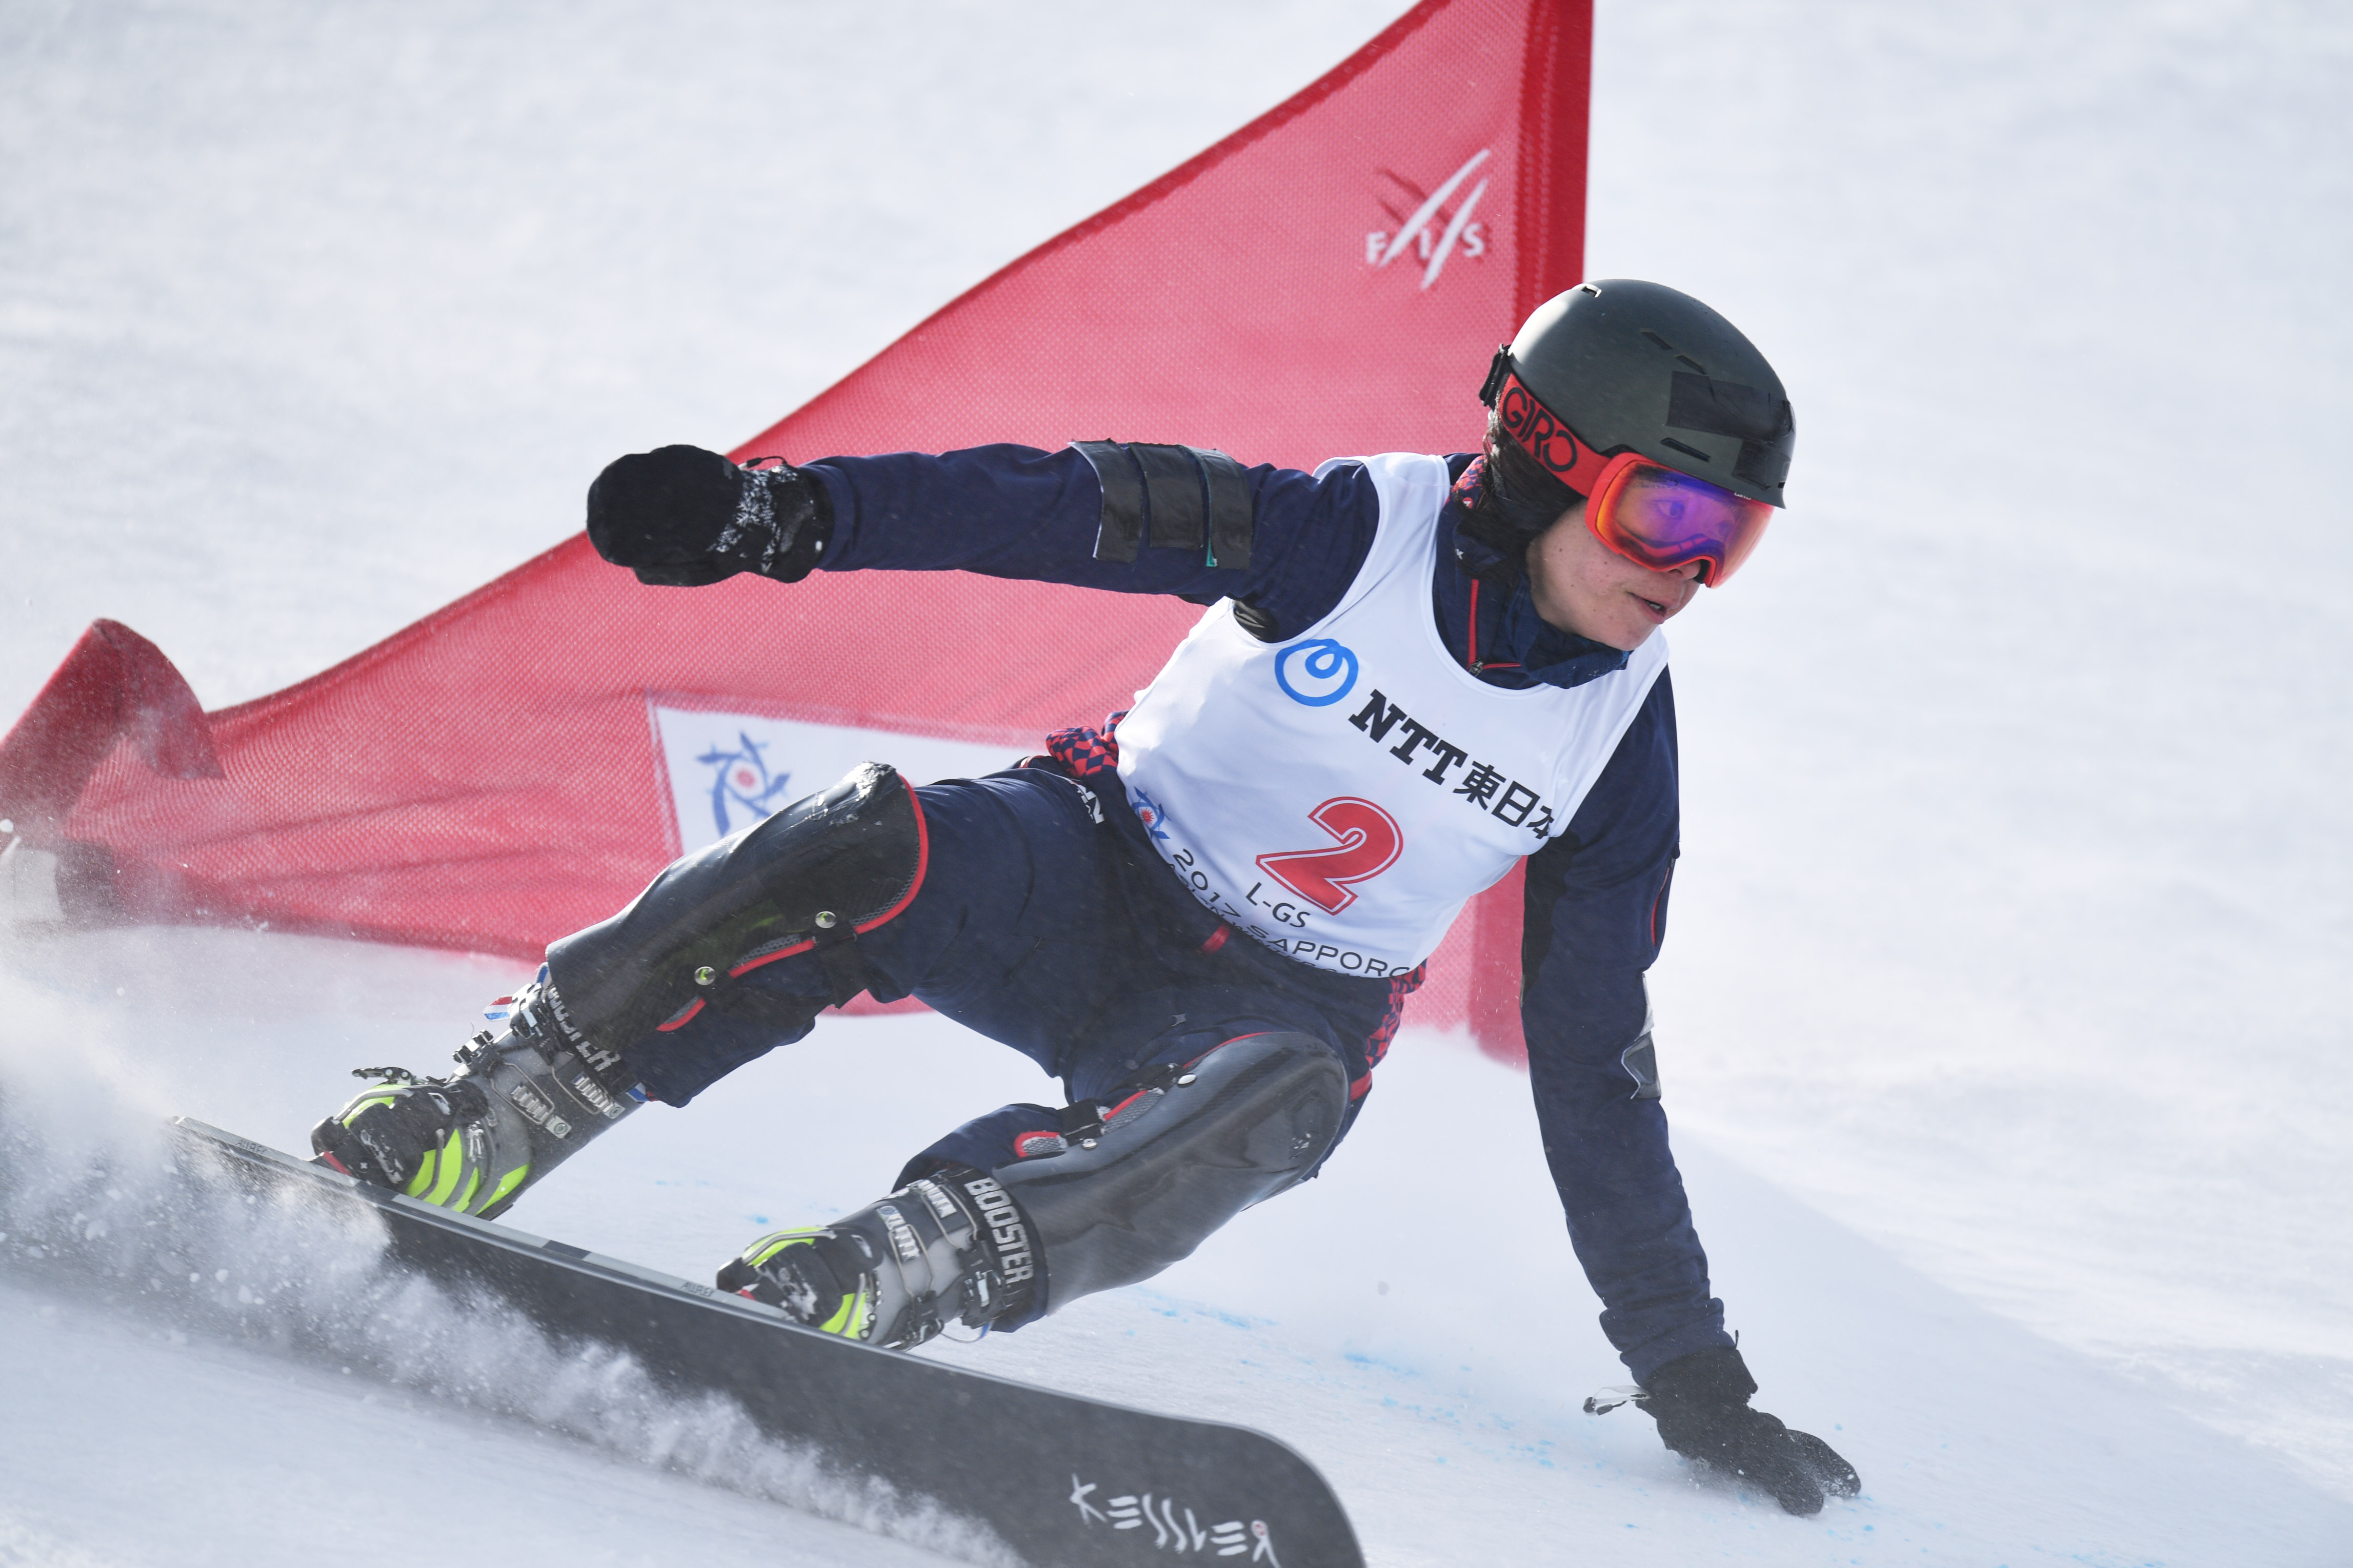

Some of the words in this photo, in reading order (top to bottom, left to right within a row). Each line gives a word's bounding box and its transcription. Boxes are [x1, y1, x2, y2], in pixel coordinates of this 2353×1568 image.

[1502, 386, 1577, 472] GIRO
[1172, 848, 1241, 918] 2017
[1255, 796, 1403, 915] 2
[1245, 881, 1311, 928] L-GS
[963, 1177, 1034, 1285] BOOSTER
[1069, 1473, 1282, 1568] KESSLER
